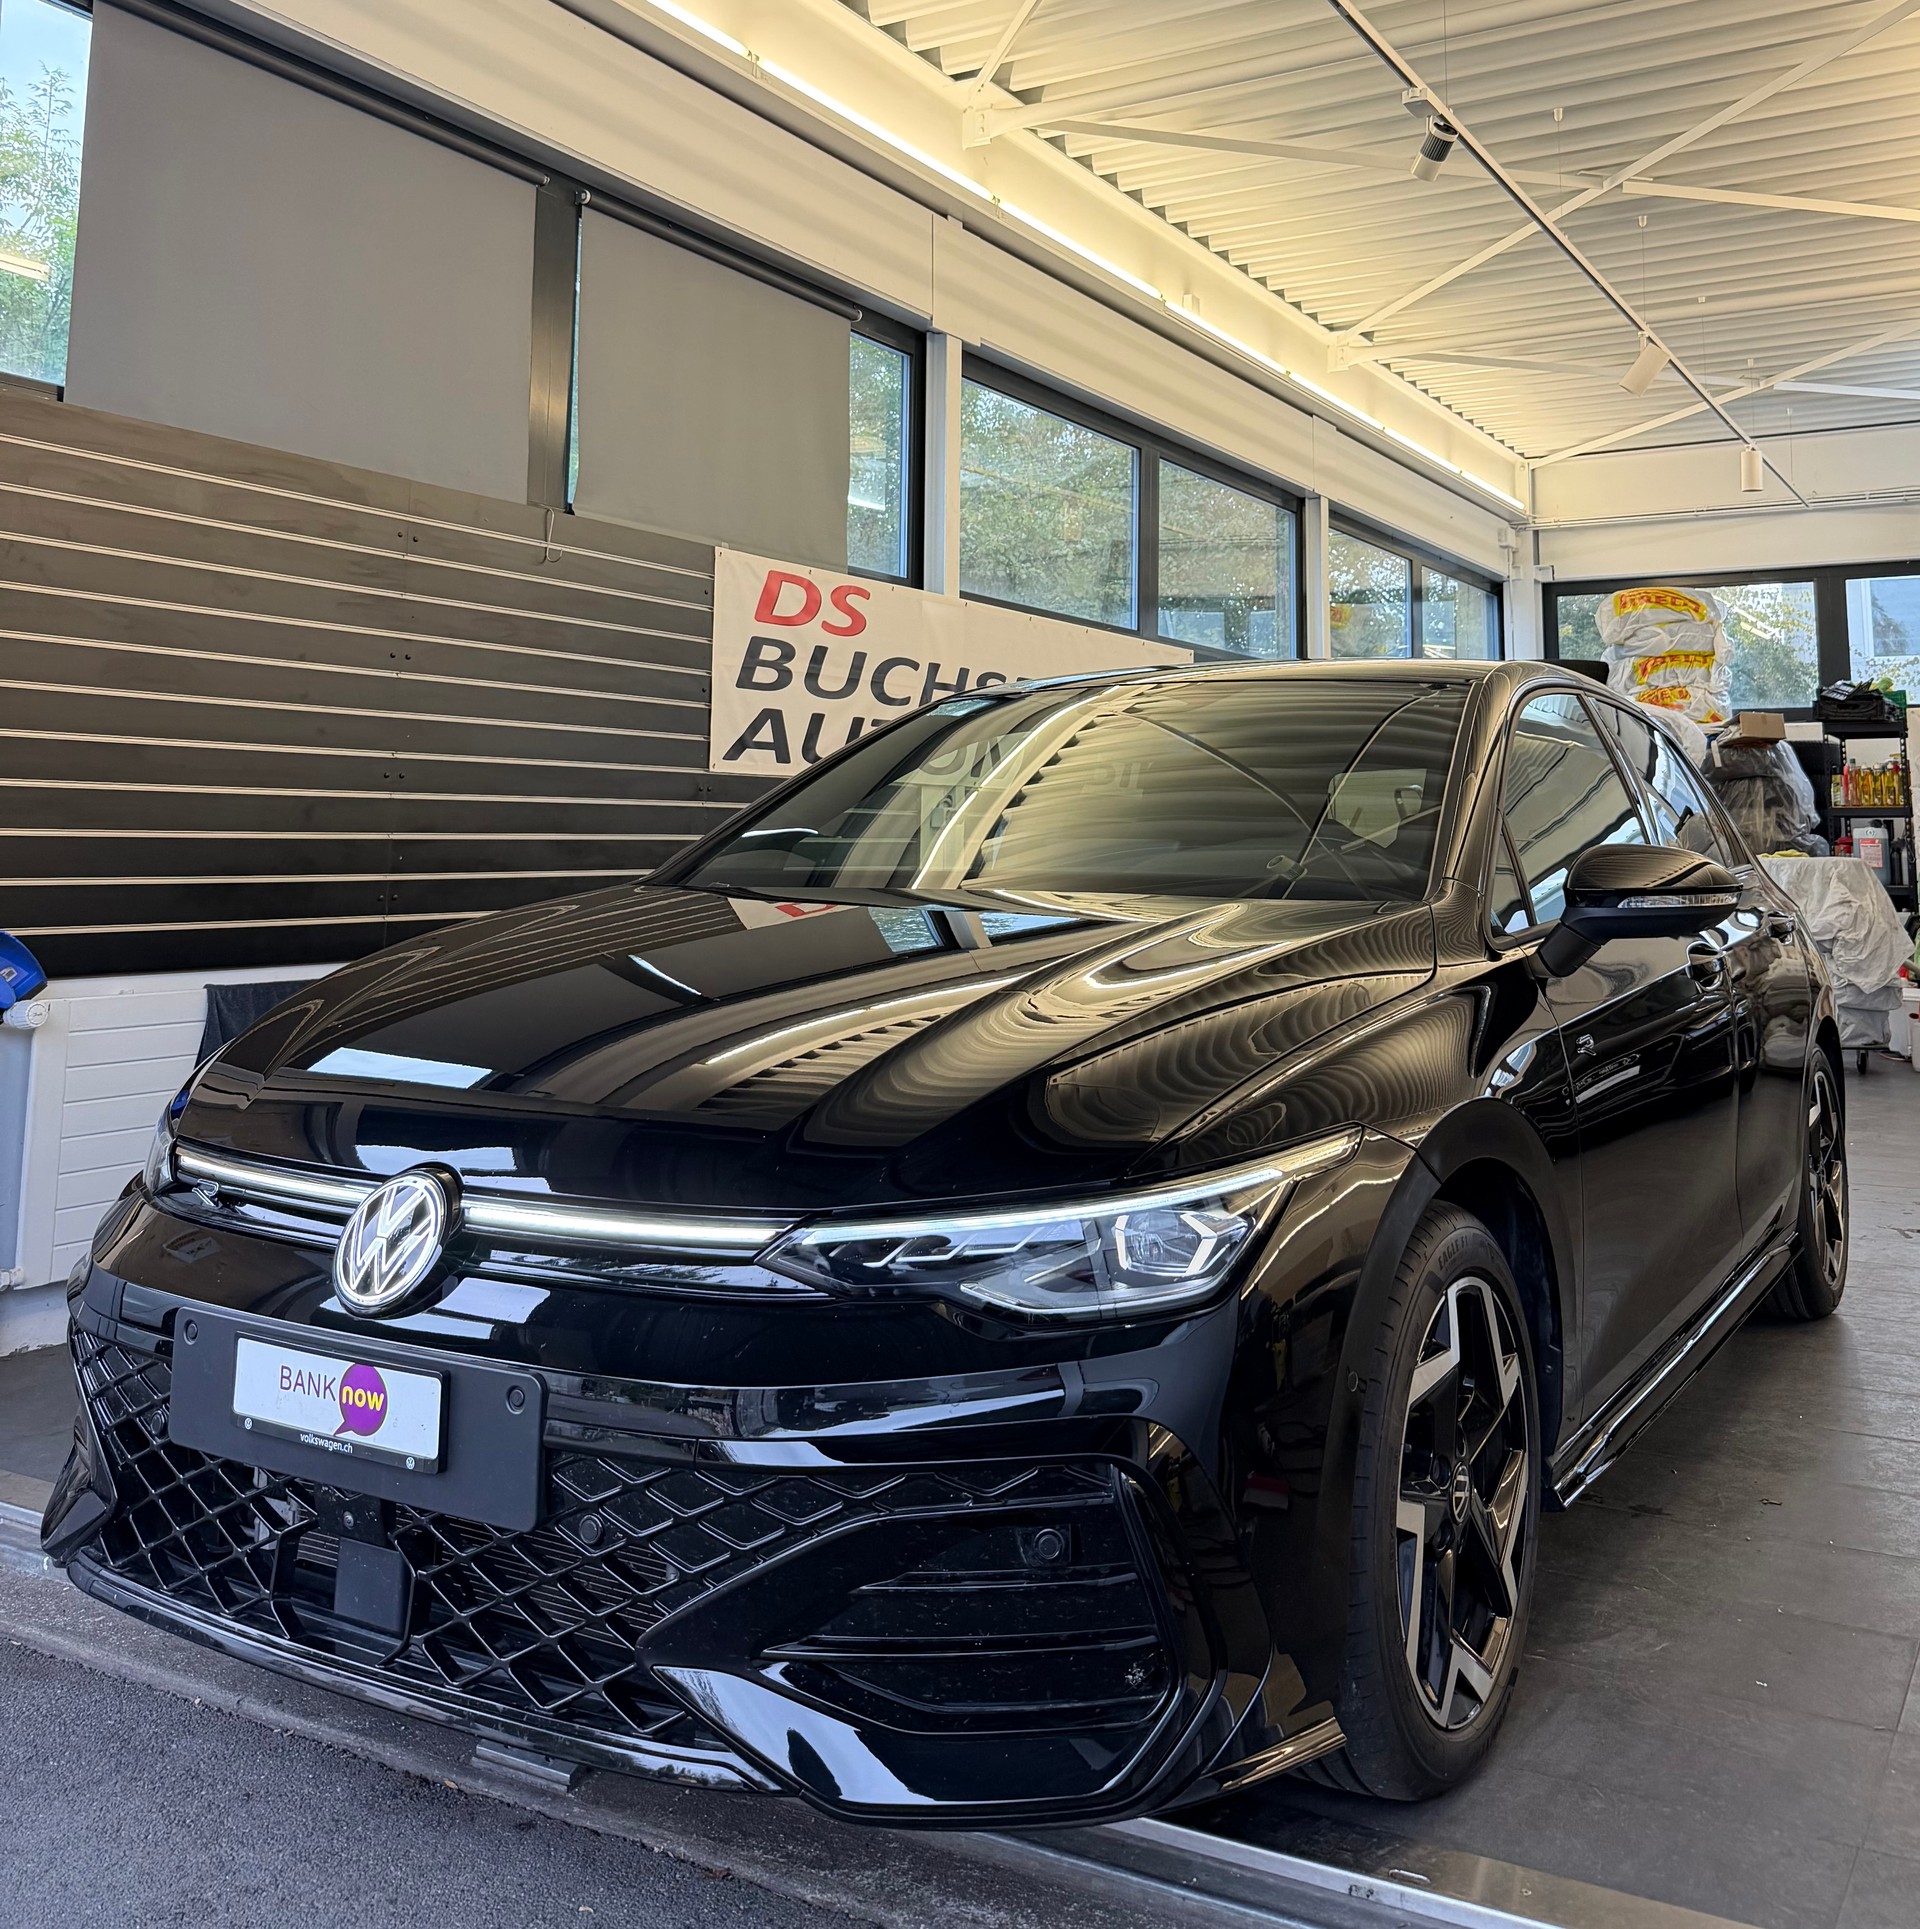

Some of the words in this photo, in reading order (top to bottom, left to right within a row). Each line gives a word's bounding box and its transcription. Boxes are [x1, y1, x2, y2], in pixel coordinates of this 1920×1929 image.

[755, 570, 870, 636] DS
[280, 1365, 336, 1401] BANK
[342, 1386, 384, 1411] now
[300, 1433, 353, 1454] volkswagen.ch
